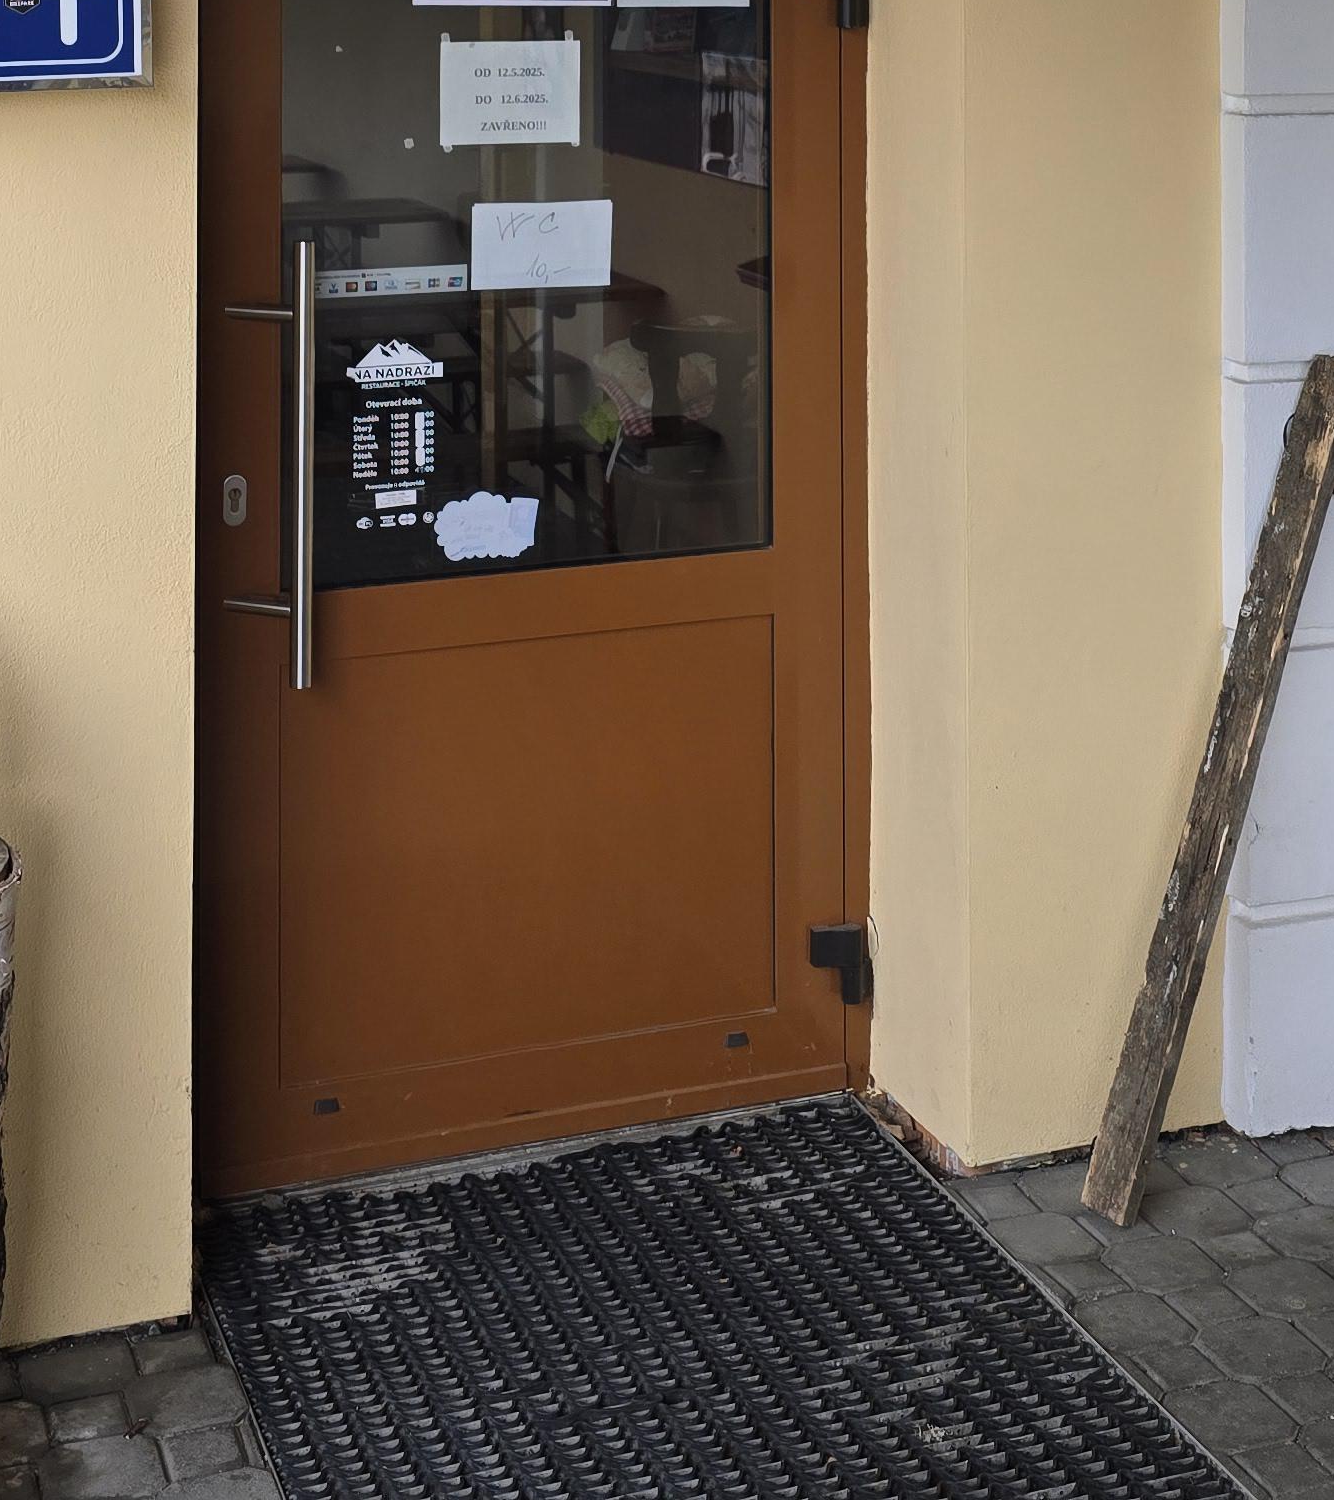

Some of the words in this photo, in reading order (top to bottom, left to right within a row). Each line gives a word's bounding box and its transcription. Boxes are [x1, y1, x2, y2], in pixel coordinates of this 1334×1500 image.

[474, 67, 491, 78] OD
[498, 67, 545, 77] 12.5.2025.
[475, 95, 492, 105] DO
[501, 93, 549, 104] 12.6.2025.
[480, 119, 547, 132] ZAVŘENO!!!
[354, 369, 371, 380] NA
